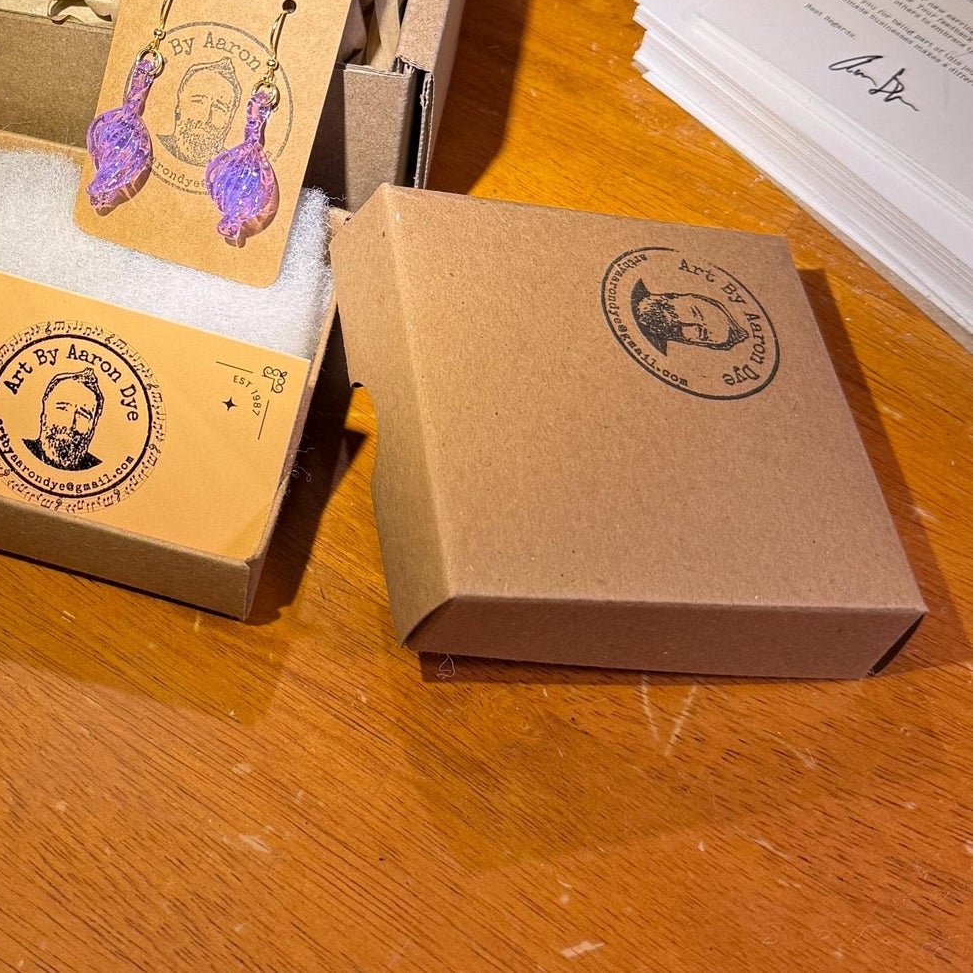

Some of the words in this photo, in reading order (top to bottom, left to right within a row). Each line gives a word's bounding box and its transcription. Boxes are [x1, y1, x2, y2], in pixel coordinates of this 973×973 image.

[168, 37, 195, 56] By
[203, 31, 263, 72] Aaron
[678, 258, 715, 283] Art
[720, 282, 747, 306] By
[743, 310, 766, 365] Aaron
[3, 361, 34, 395] Art
[33, 347, 60, 366] By
[66, 344, 123, 383] Aaron
[120, 384, 139, 422] Dye
[233, 375, 252, 388] EST
[250, 389, 262, 416] 1987
[721, 364, 760, 386] Dye
